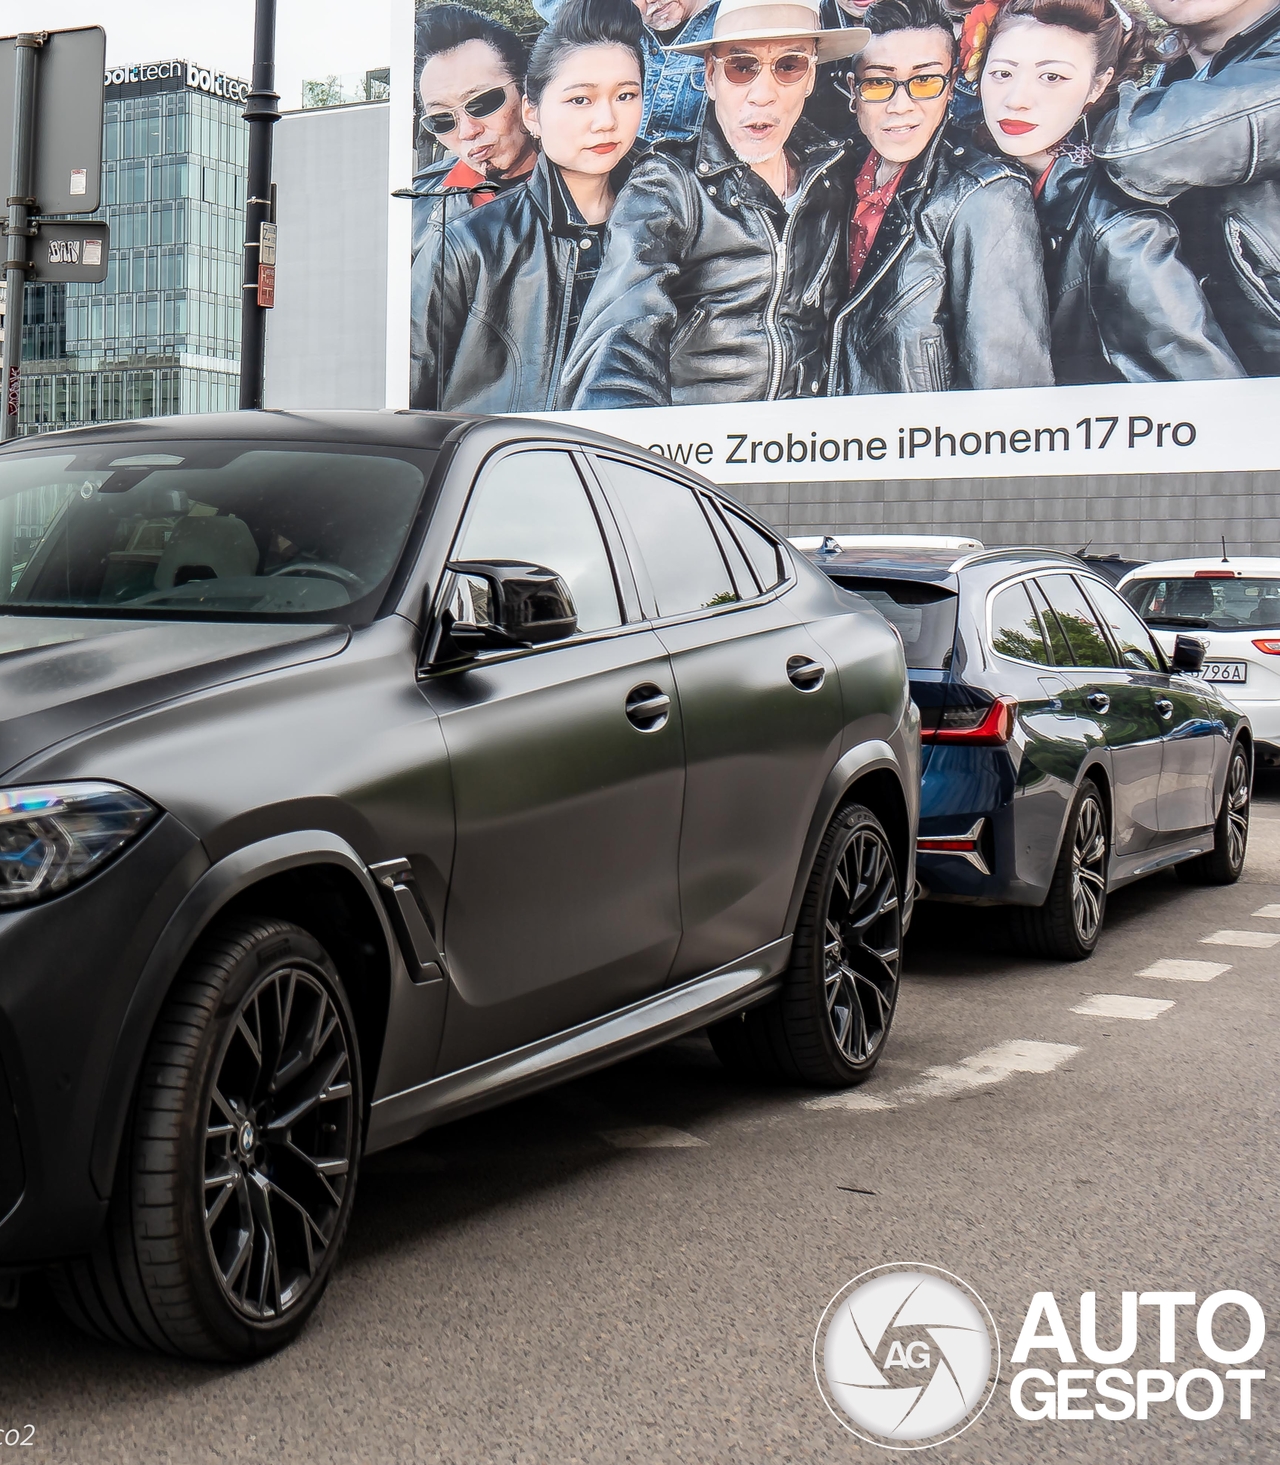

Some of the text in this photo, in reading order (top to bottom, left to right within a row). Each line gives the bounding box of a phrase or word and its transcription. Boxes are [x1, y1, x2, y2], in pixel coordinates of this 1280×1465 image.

[185, 59, 253, 104] bolttec
[725, 432, 888, 464] Zrobione
[898, 426, 1070, 459] iPhonem
[1076, 416, 1119, 449] 17
[1128, 416, 1197, 448] Pro
[1191, 665, 1241, 680] 796A
